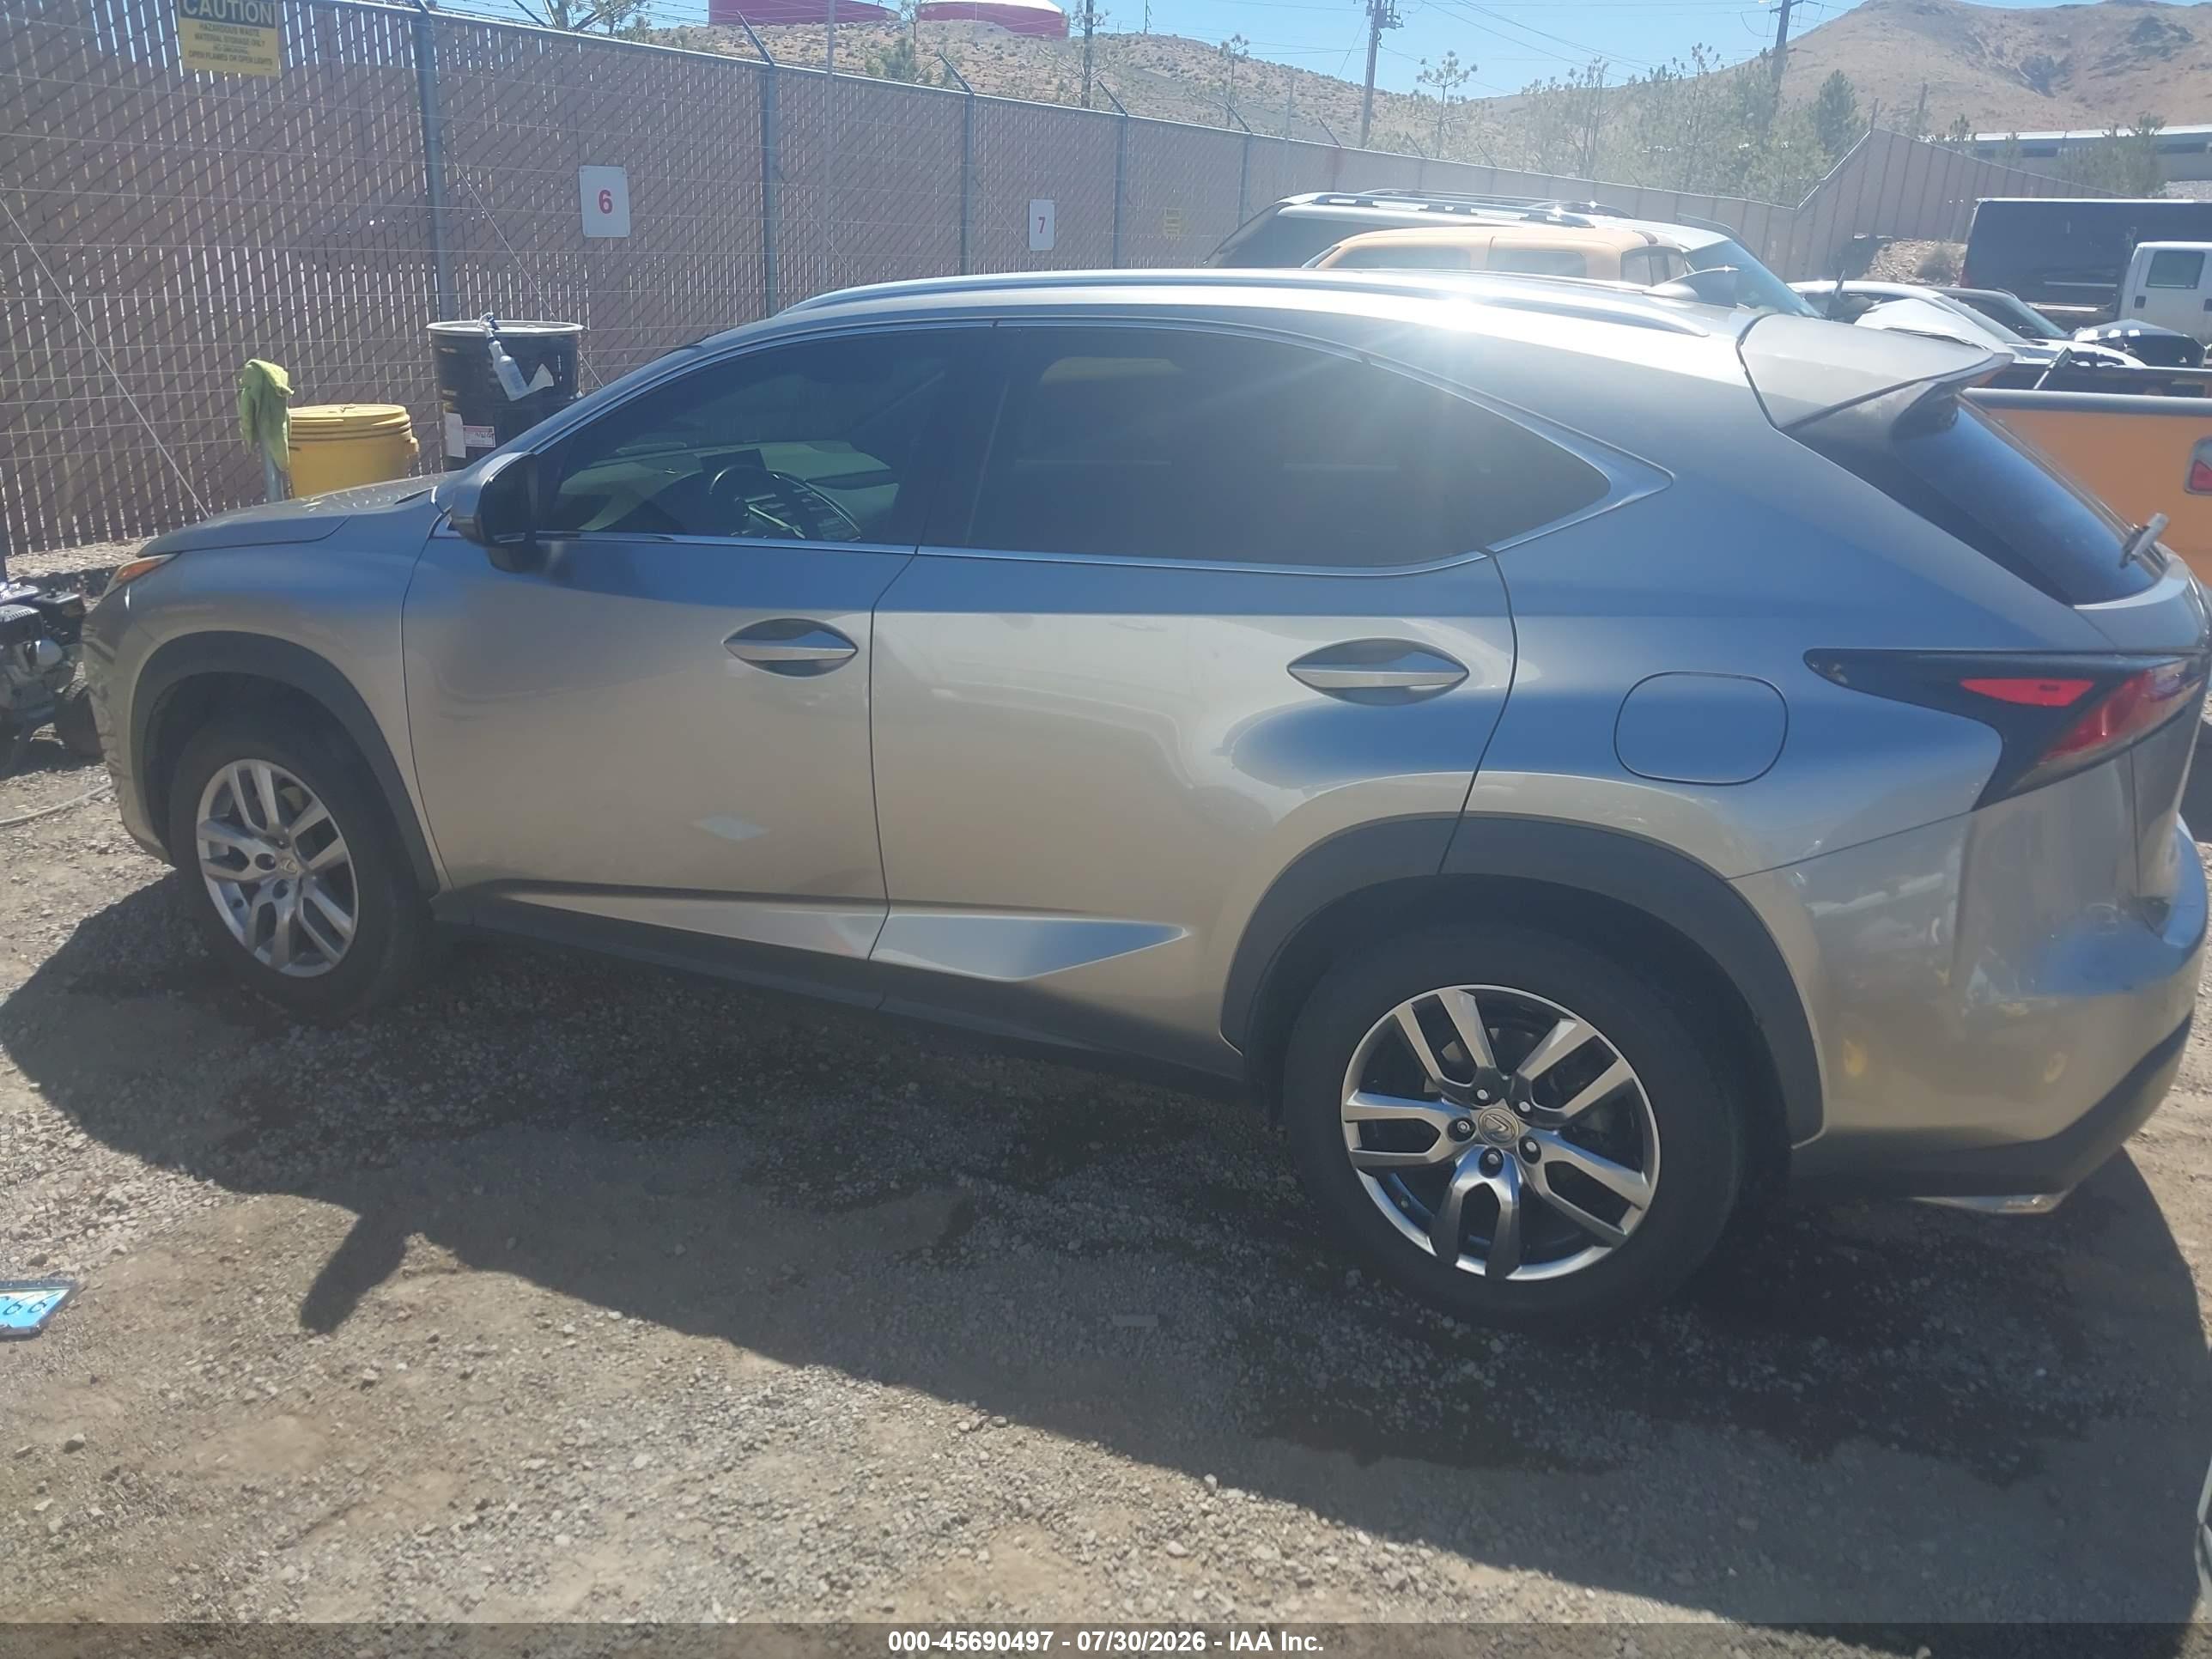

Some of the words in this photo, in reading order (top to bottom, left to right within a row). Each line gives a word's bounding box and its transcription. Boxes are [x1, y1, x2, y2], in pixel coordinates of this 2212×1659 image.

[183, 0, 272, 24] CAUTION
[599, 190, 613, 214] 6
[1038, 216, 1046, 234] 7
